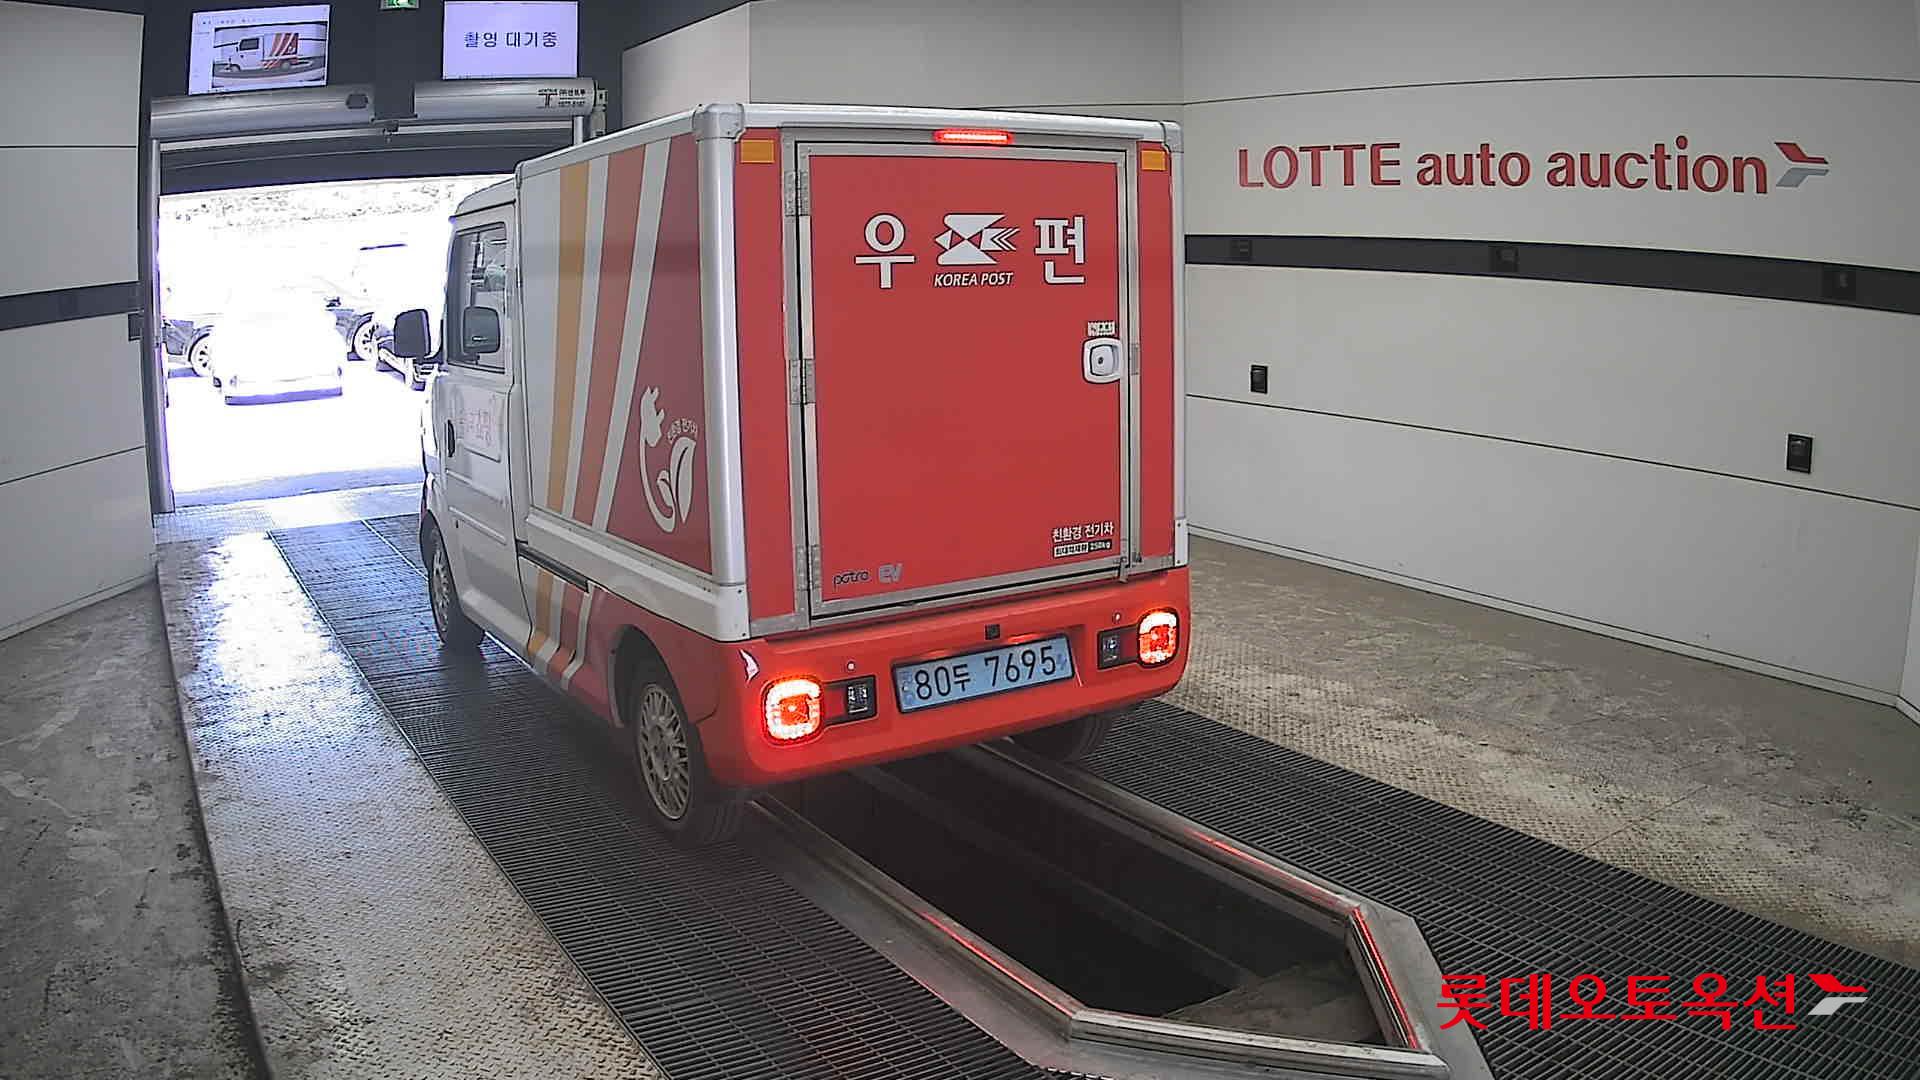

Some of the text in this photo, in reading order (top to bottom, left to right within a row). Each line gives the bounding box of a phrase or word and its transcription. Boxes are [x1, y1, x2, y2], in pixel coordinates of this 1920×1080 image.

[464, 31, 558, 48] 촬영 대기중
[1237, 134, 1769, 195] LOTTE auto auction
[854, 212, 1086, 290] 우 편
[933, 271, 1015, 288] KOREA POST
[1052, 521, 1115, 544] 친환경 전기차
[913, 663, 972, 701] 80두
[984, 645, 1057, 687] 7695
